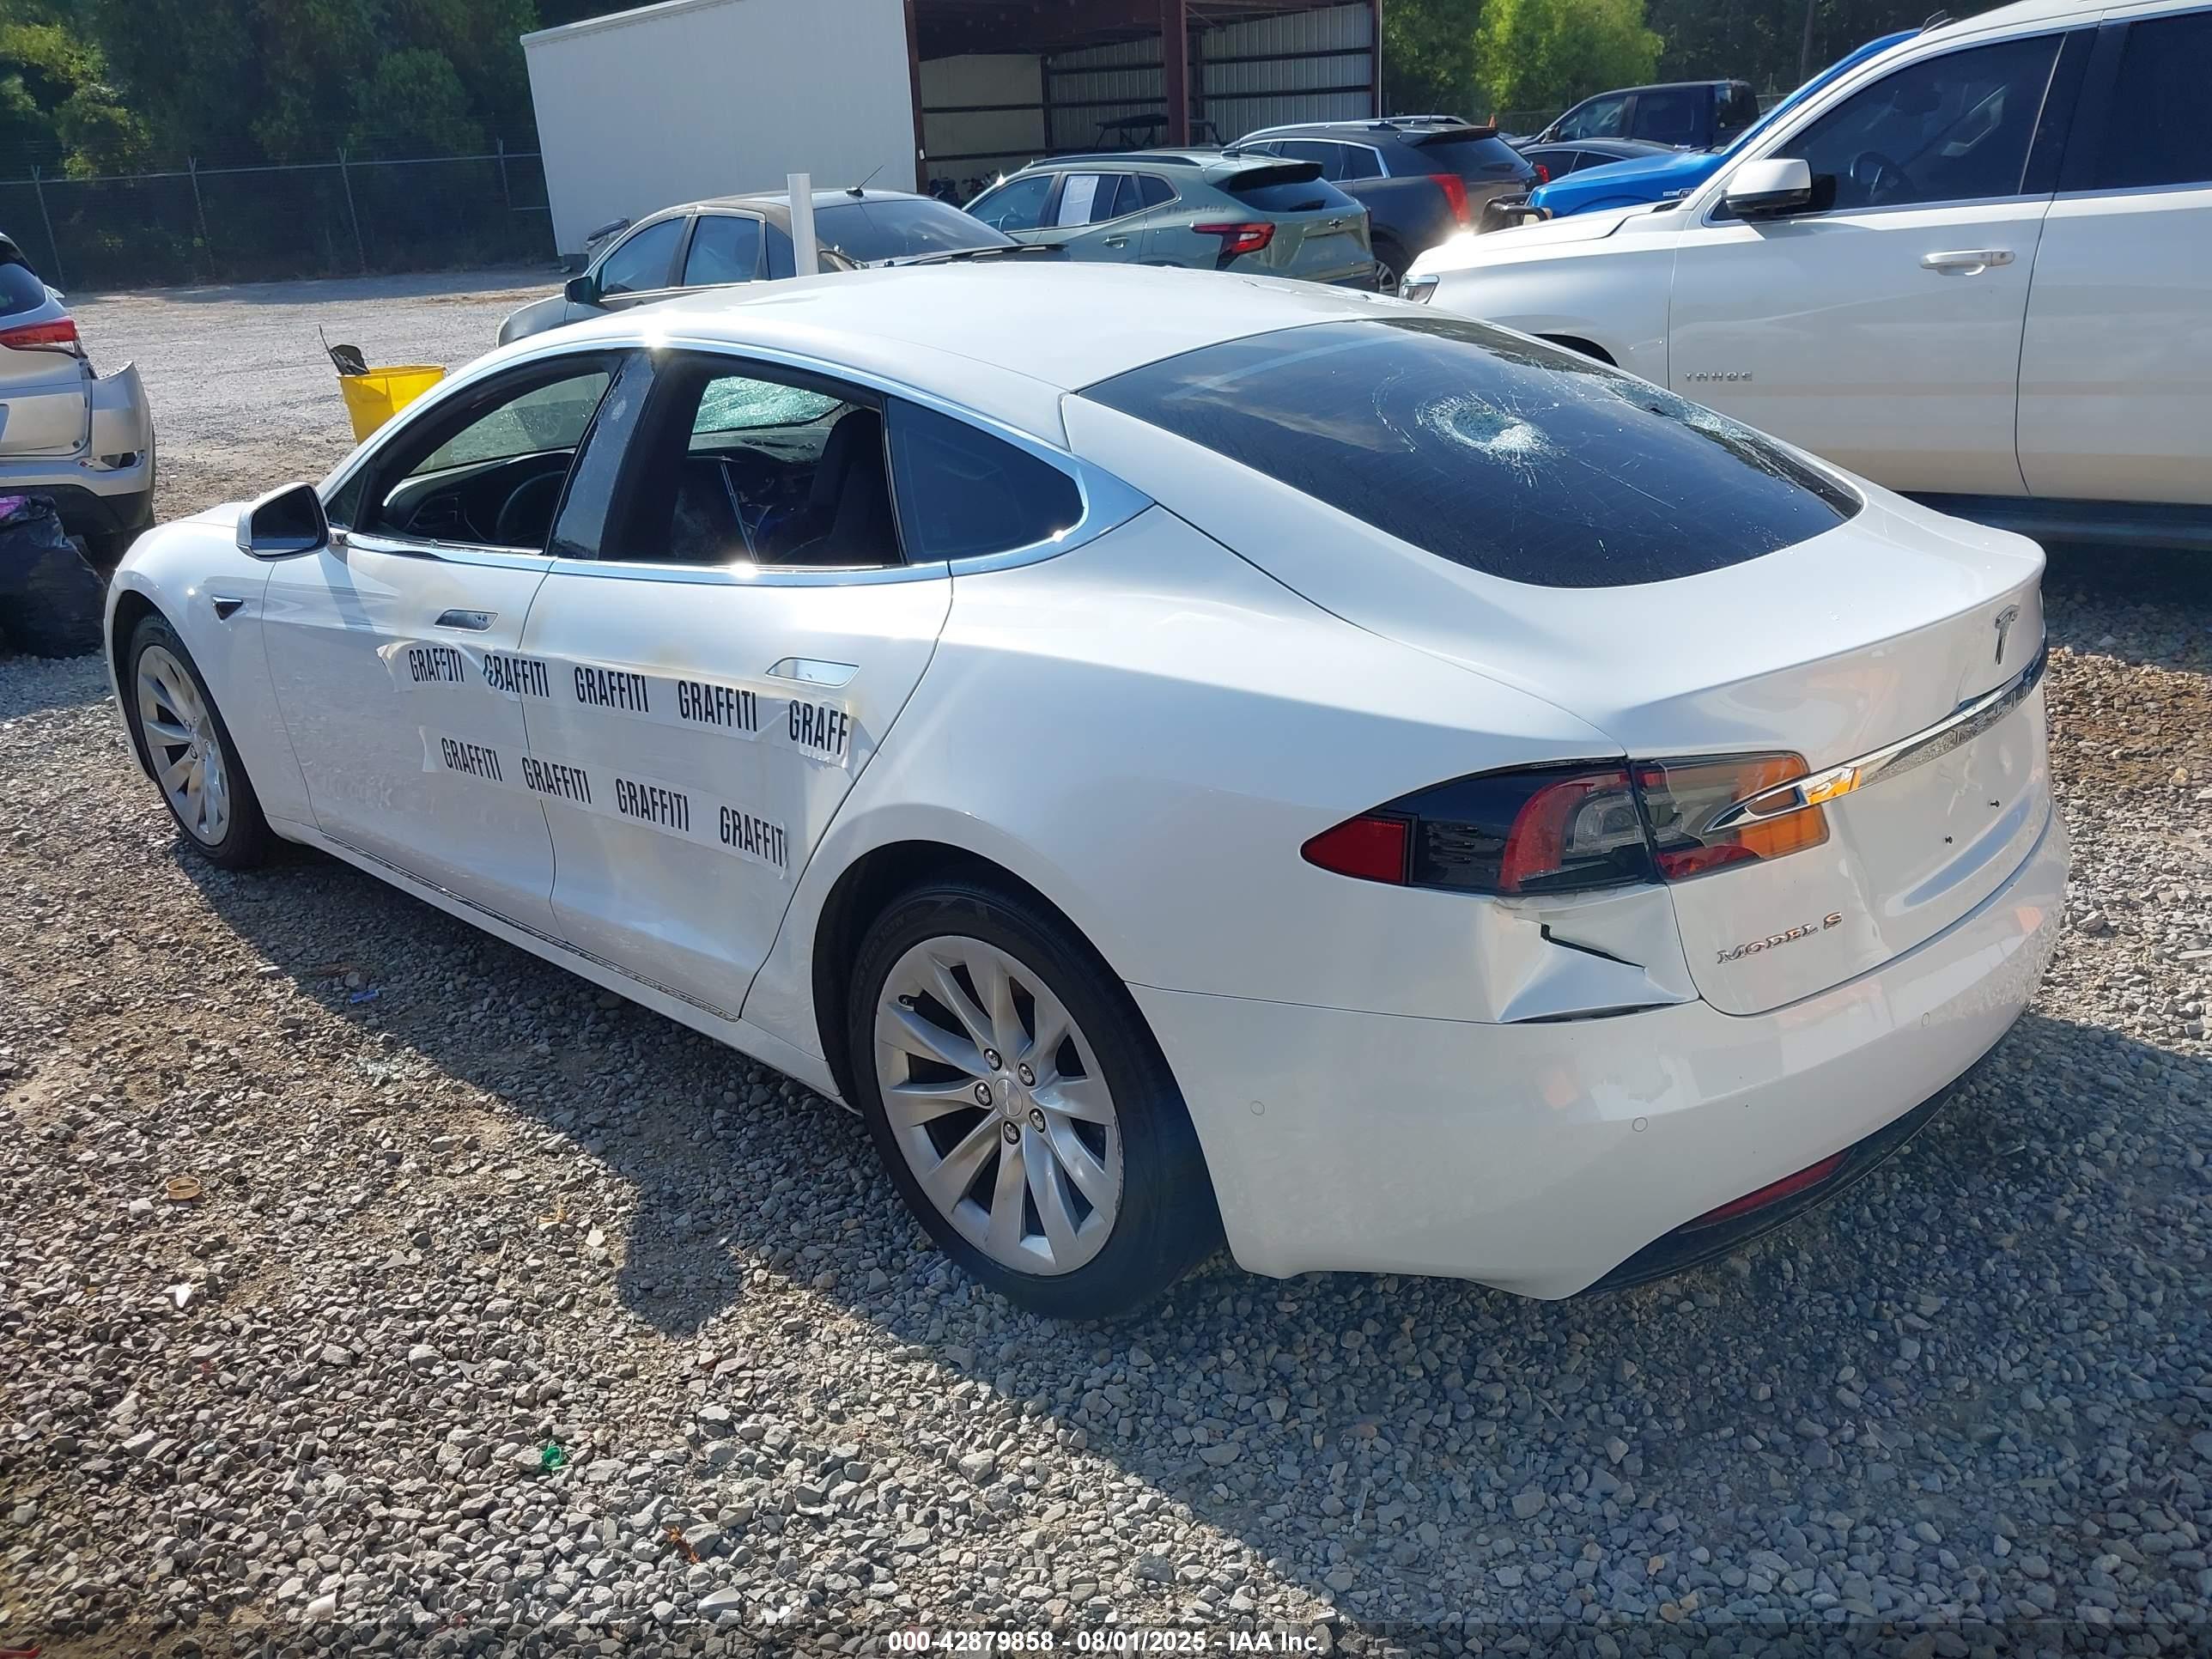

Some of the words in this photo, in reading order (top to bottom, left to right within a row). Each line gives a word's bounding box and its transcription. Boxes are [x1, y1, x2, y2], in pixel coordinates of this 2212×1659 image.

[1684, 371, 1753, 383] TAHOE
[409, 647, 465, 684] GRAFFITI
[483, 653, 550, 698] GRAFFITI
[574, 665, 649, 714] GRAFFITI
[678, 679, 757, 732] GRAFFITI
[441, 737, 503, 782] GRAFFITI
[521, 757, 592, 805] GRAFFITI
[616, 778, 690, 832] GRAFFITI
[1717, 923, 1819, 964] MODEL
[1823, 911, 1843, 930] S
